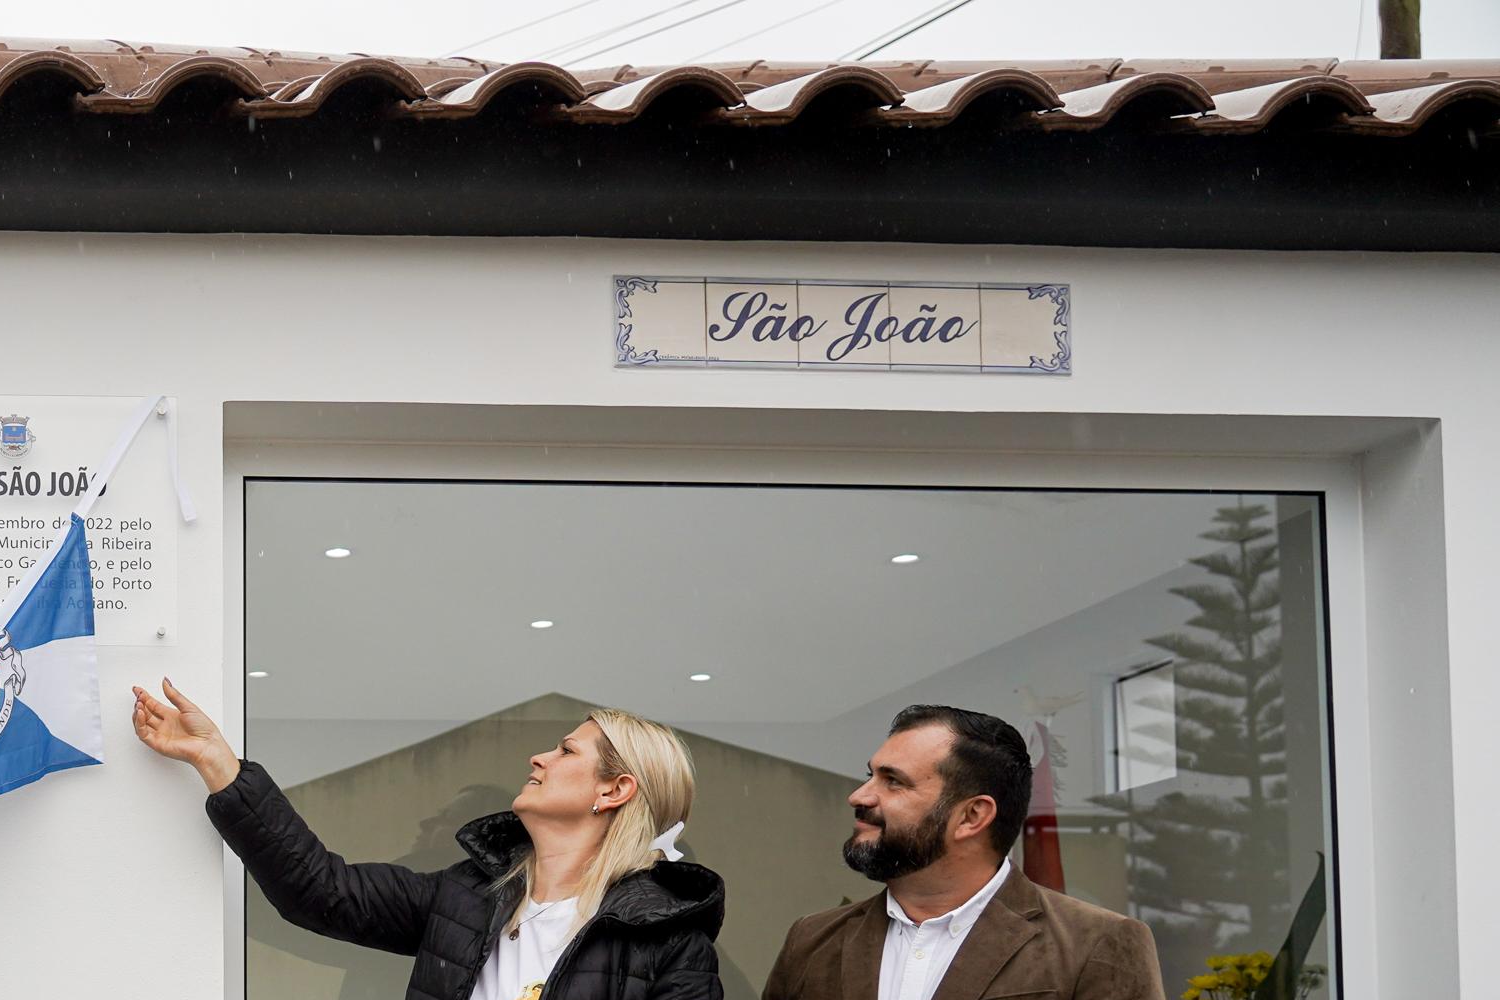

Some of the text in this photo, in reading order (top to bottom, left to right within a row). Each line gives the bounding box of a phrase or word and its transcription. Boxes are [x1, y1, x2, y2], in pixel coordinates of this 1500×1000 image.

[708, 291, 979, 362] São João
[83, 517, 113, 531] 022
[120, 517, 152, 533] pelo
[102, 537, 152, 550] Ribeira
[106, 559, 115, 570] e
[120, 557, 152, 573] pelo
[113, 577, 152, 590] Porto
